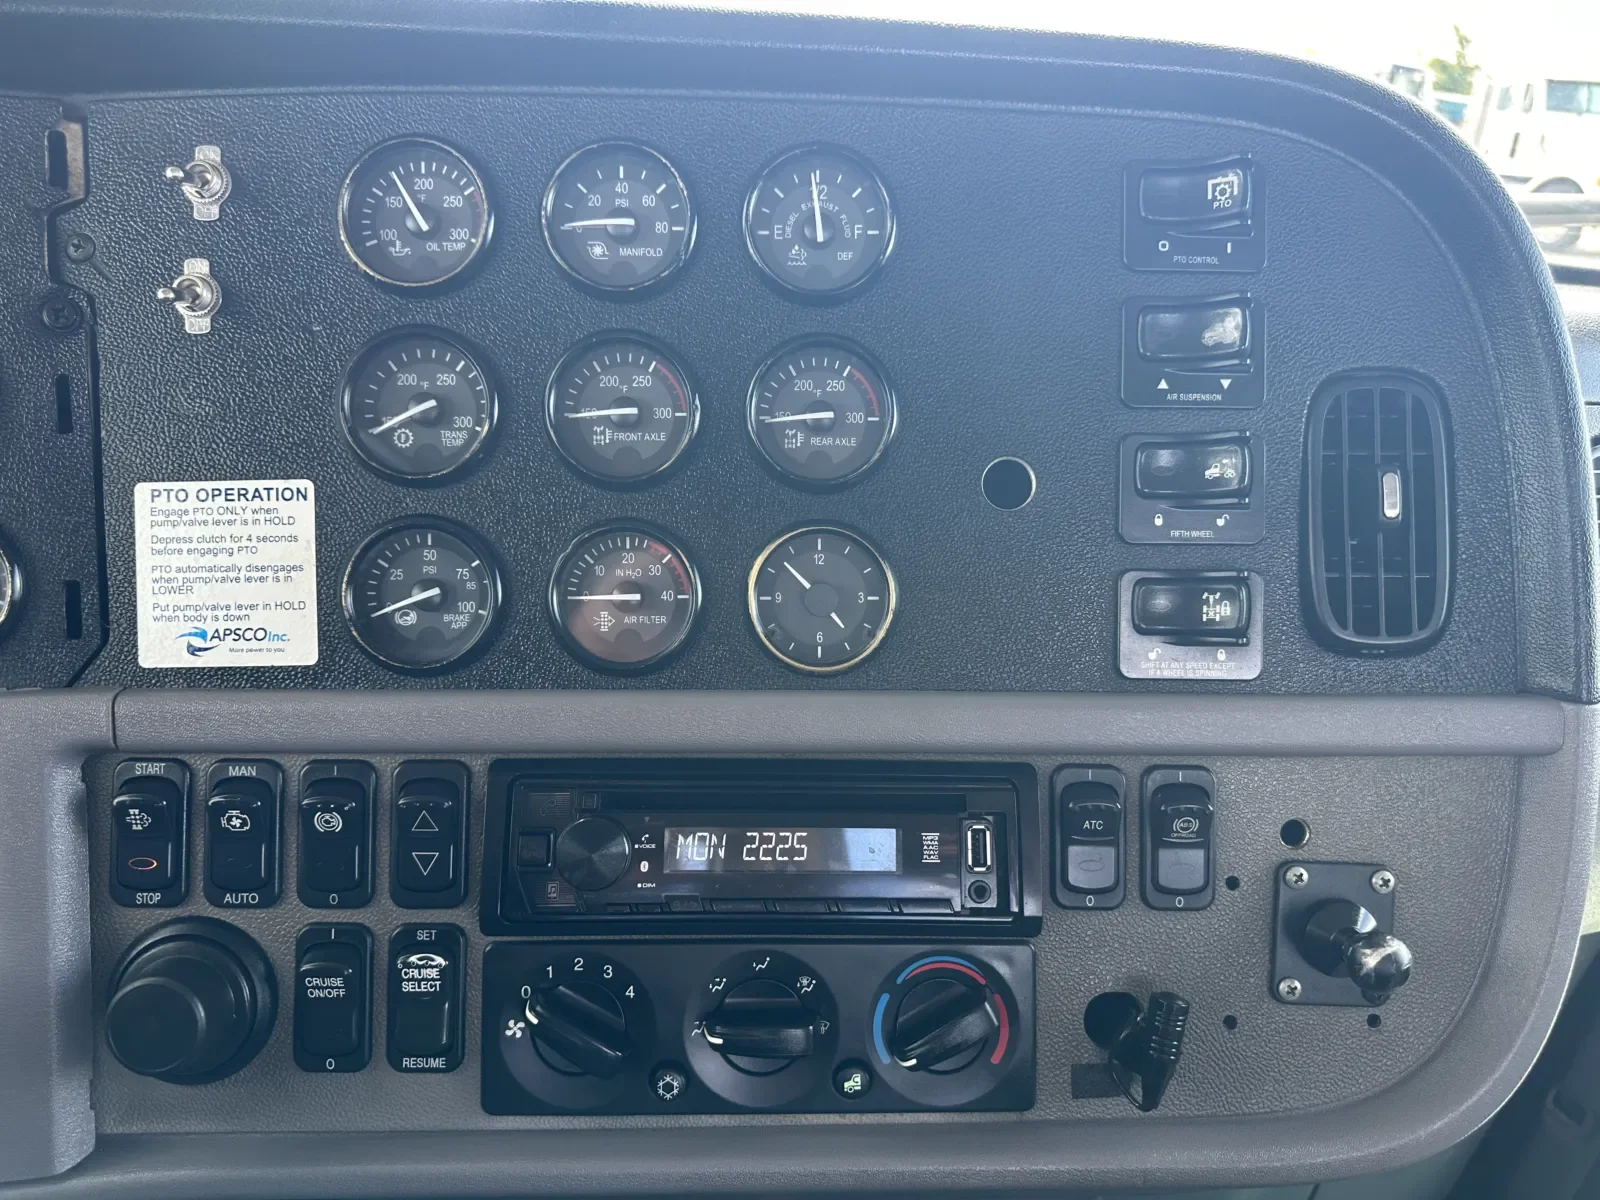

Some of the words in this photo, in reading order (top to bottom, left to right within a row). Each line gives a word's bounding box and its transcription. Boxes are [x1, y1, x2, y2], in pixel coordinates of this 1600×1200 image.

[414, 178, 434, 190] 200
[615, 182, 629, 194] 40
[385, 196, 403, 208] 150
[443, 196, 463, 208] 250
[588, 195, 602, 207] 20
[615, 199, 629, 208] PSI
[642, 195, 656, 207] 60
[1213, 199, 1232, 210] PTO
[785, 212, 800, 239] DIESEL
[801, 200, 840, 213] EXAUST
[839, 214, 851, 239] FLUID
[655, 222, 669, 234] 80
[774, 225, 783, 240] E
[854, 225, 863, 240] F
[379, 229, 397, 241] 100
[449, 228, 469, 240] 300
[426, 242, 440, 251] OIL
[442, 242, 466, 251] TEMP
[619, 248, 663, 257] MANIFOLD
[837, 252, 853, 261] DEF
[1188, 256, 1219, 264] CONTROL
[397, 374, 417, 386] 200
[436, 374, 456, 386] 250
[600, 376, 619, 387] 200
[632, 376, 652, 387] 250
[794, 380, 813, 391] 200
[826, 380, 845, 391] 250
[653, 408, 672, 419] 300
[846, 412, 864, 424] 300
[453, 416, 473, 428] 300
[440, 431, 468, 439] TRANS
[614, 432, 642, 441] FRONT
[644, 432, 666, 441] AXLE
[441, 438, 464, 446] TEMP
[810, 437, 833, 446] REAR
[835, 437, 857, 446] AXLE
[150, 488, 189, 503] PTO
[195, 487, 308, 502] OPERATION
[150, 507, 189, 518] Engage
[193, 507, 213, 515] PTO
[217, 506, 248, 515] ONLY
[251, 506, 278, 515] when
[150, 518, 209, 529] pump/valve
[211, 517, 237, 526] lever
[240, 517, 249, 526] is
[252, 517, 260, 525] in
[264, 516, 295, 525] HOLD
[151, 535, 193, 546] Depress
[196, 534, 226, 543] clutch
[230, 534, 243, 543] for
[246, 534, 252, 543] 4
[256, 534, 299, 543] seconds
[151, 546, 184, 555] before
[186, 546, 234, 557] engaging
[237, 546, 258, 554] PTO
[423, 550, 437, 561] 50
[622, 552, 635, 564] 20
[813, 554, 825, 565] 12
[151, 565, 172, 574] PTO
[175, 564, 242, 575] automatically
[245, 563, 304, 575] disengages
[423, 566, 437, 574] PSI
[456, 568, 470, 580] 75
[594, 565, 605, 576] 10
[615, 569, 624, 577] IN
[648, 565, 662, 576] 30
[152, 576, 179, 584] when
[182, 575, 241, 586] pump/valve
[244, 574, 269, 583] lever
[272, 574, 280, 583] is
[283, 574, 293, 583] in
[390, 569, 404, 581] 25
[152, 586, 194, 595] LOWER
[466, 582, 476, 590] 85
[661, 591, 674, 602] 40
[775, 592, 782, 603] 9
[858, 592, 864, 603] 3
[152, 603, 170, 612] Put
[172, 602, 231, 614] pump/valve
[234, 602, 259, 611] lever
[262, 601, 272, 610] in
[275, 601, 306, 610] HOLD
[458, 601, 475, 613] 100
[152, 614, 180, 623] when
[183, 613, 208, 624] body
[211, 613, 220, 622] is
[223, 613, 250, 622] down
[443, 614, 471, 622] BRAKE
[624, 616, 637, 624] AIR
[639, 616, 667, 624] FILTER
[451, 621, 467, 629] APP
[816, 632, 823, 643] 6
[1185, 661, 1207, 669] SPEED
[135, 763, 166, 775] START
[228, 766, 257, 776] MAN
[1083, 820, 1104, 830] ATC
[676, 832, 727, 860] MON
[742, 832, 808, 861] 2225
[135, 893, 161, 904] STOP
[224, 893, 259, 904] AUTO
[416, 930, 437, 941] SET
[574, 957, 584, 971] 2
[401, 968, 440, 979] CRUISE
[546, 965, 553, 979] 1
[603, 965, 613, 978] 3
[305, 977, 344, 987] CRUISE
[401, 981, 441, 992] SELECT
[307, 988, 346, 998] ON/OFF
[521, 985, 531, 999] 0
[625, 985, 635, 999] 4
[402, 1057, 446, 1068] RESUME
